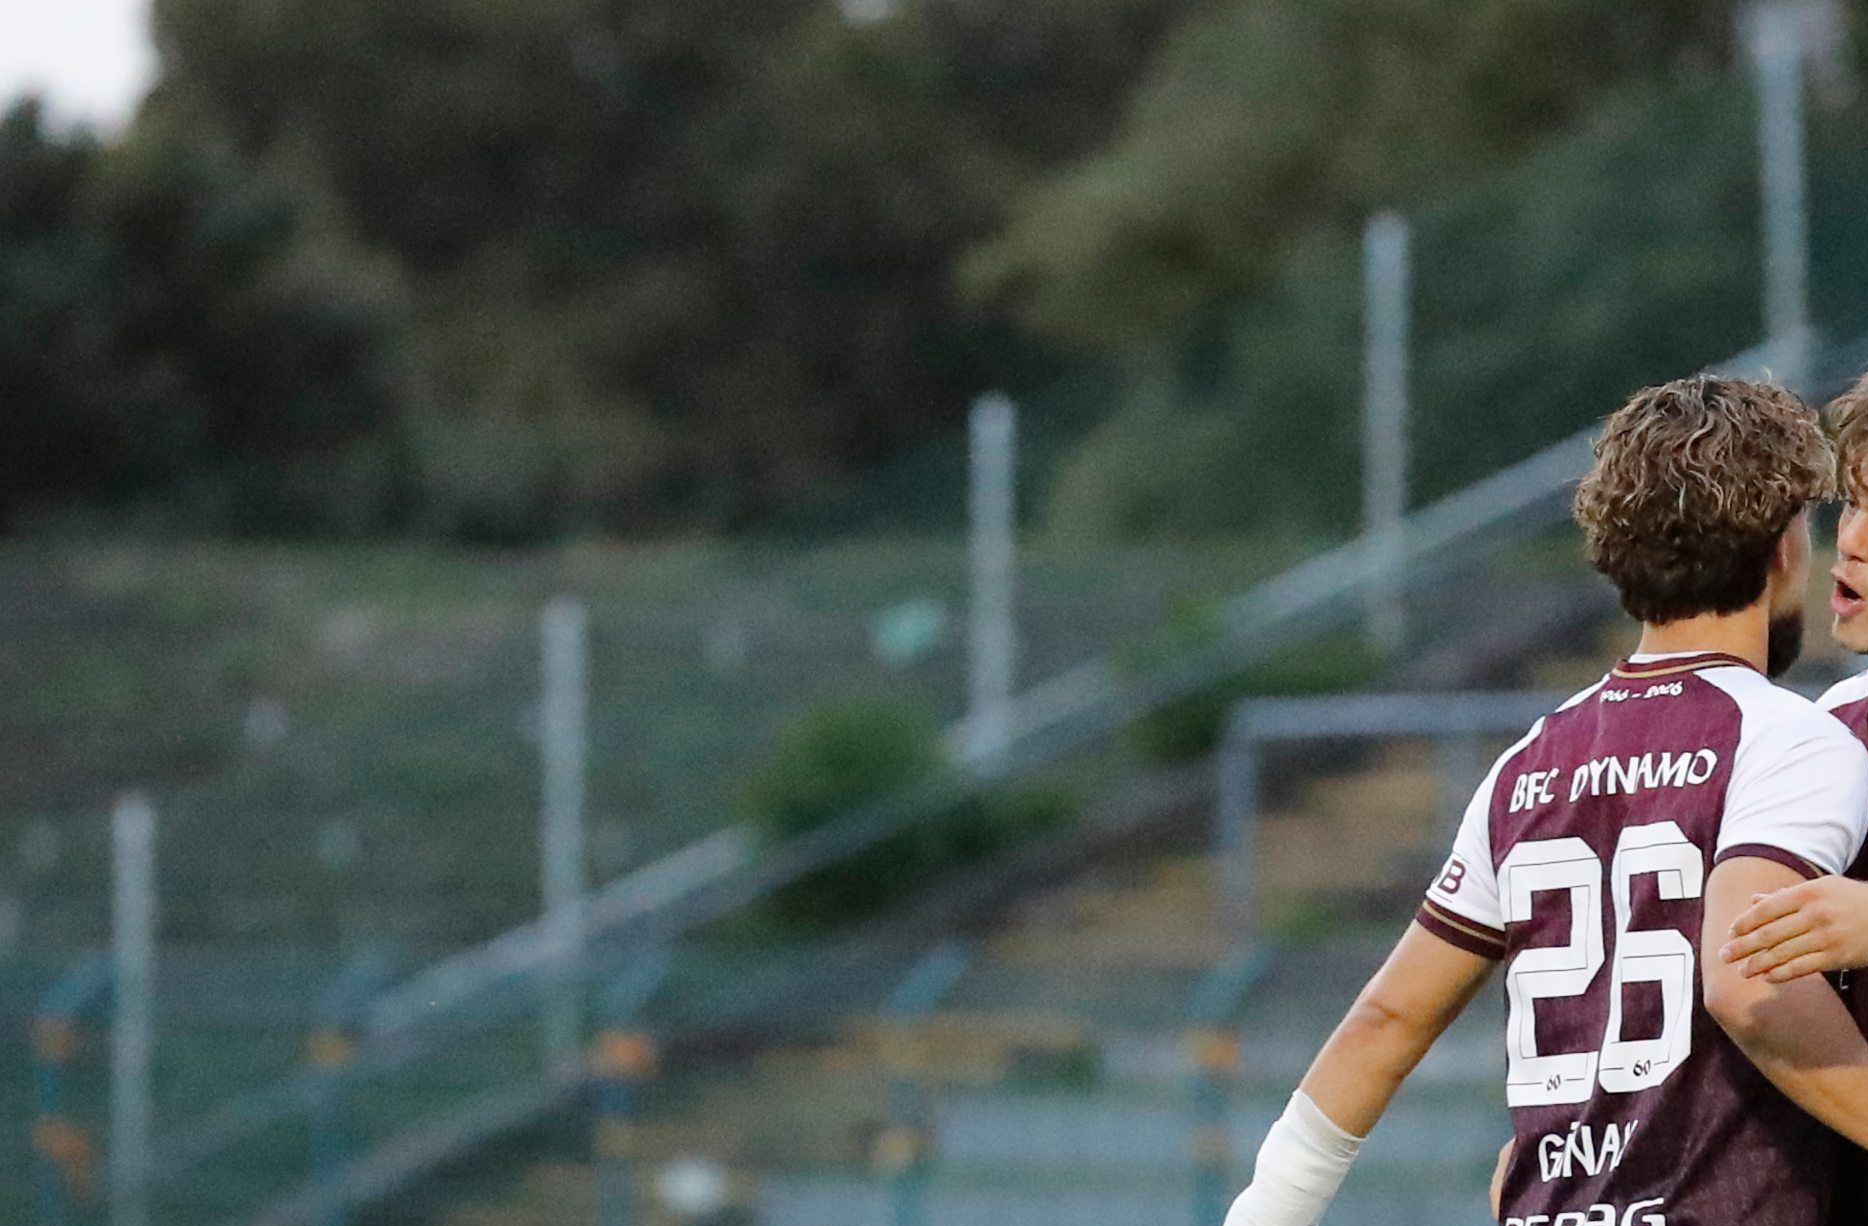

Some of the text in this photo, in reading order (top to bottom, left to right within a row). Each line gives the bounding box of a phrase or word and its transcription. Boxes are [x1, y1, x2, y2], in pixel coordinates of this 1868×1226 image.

[1508, 748, 1718, 813] BFC DYNAMO
[1497, 821, 1704, 1107] 26
